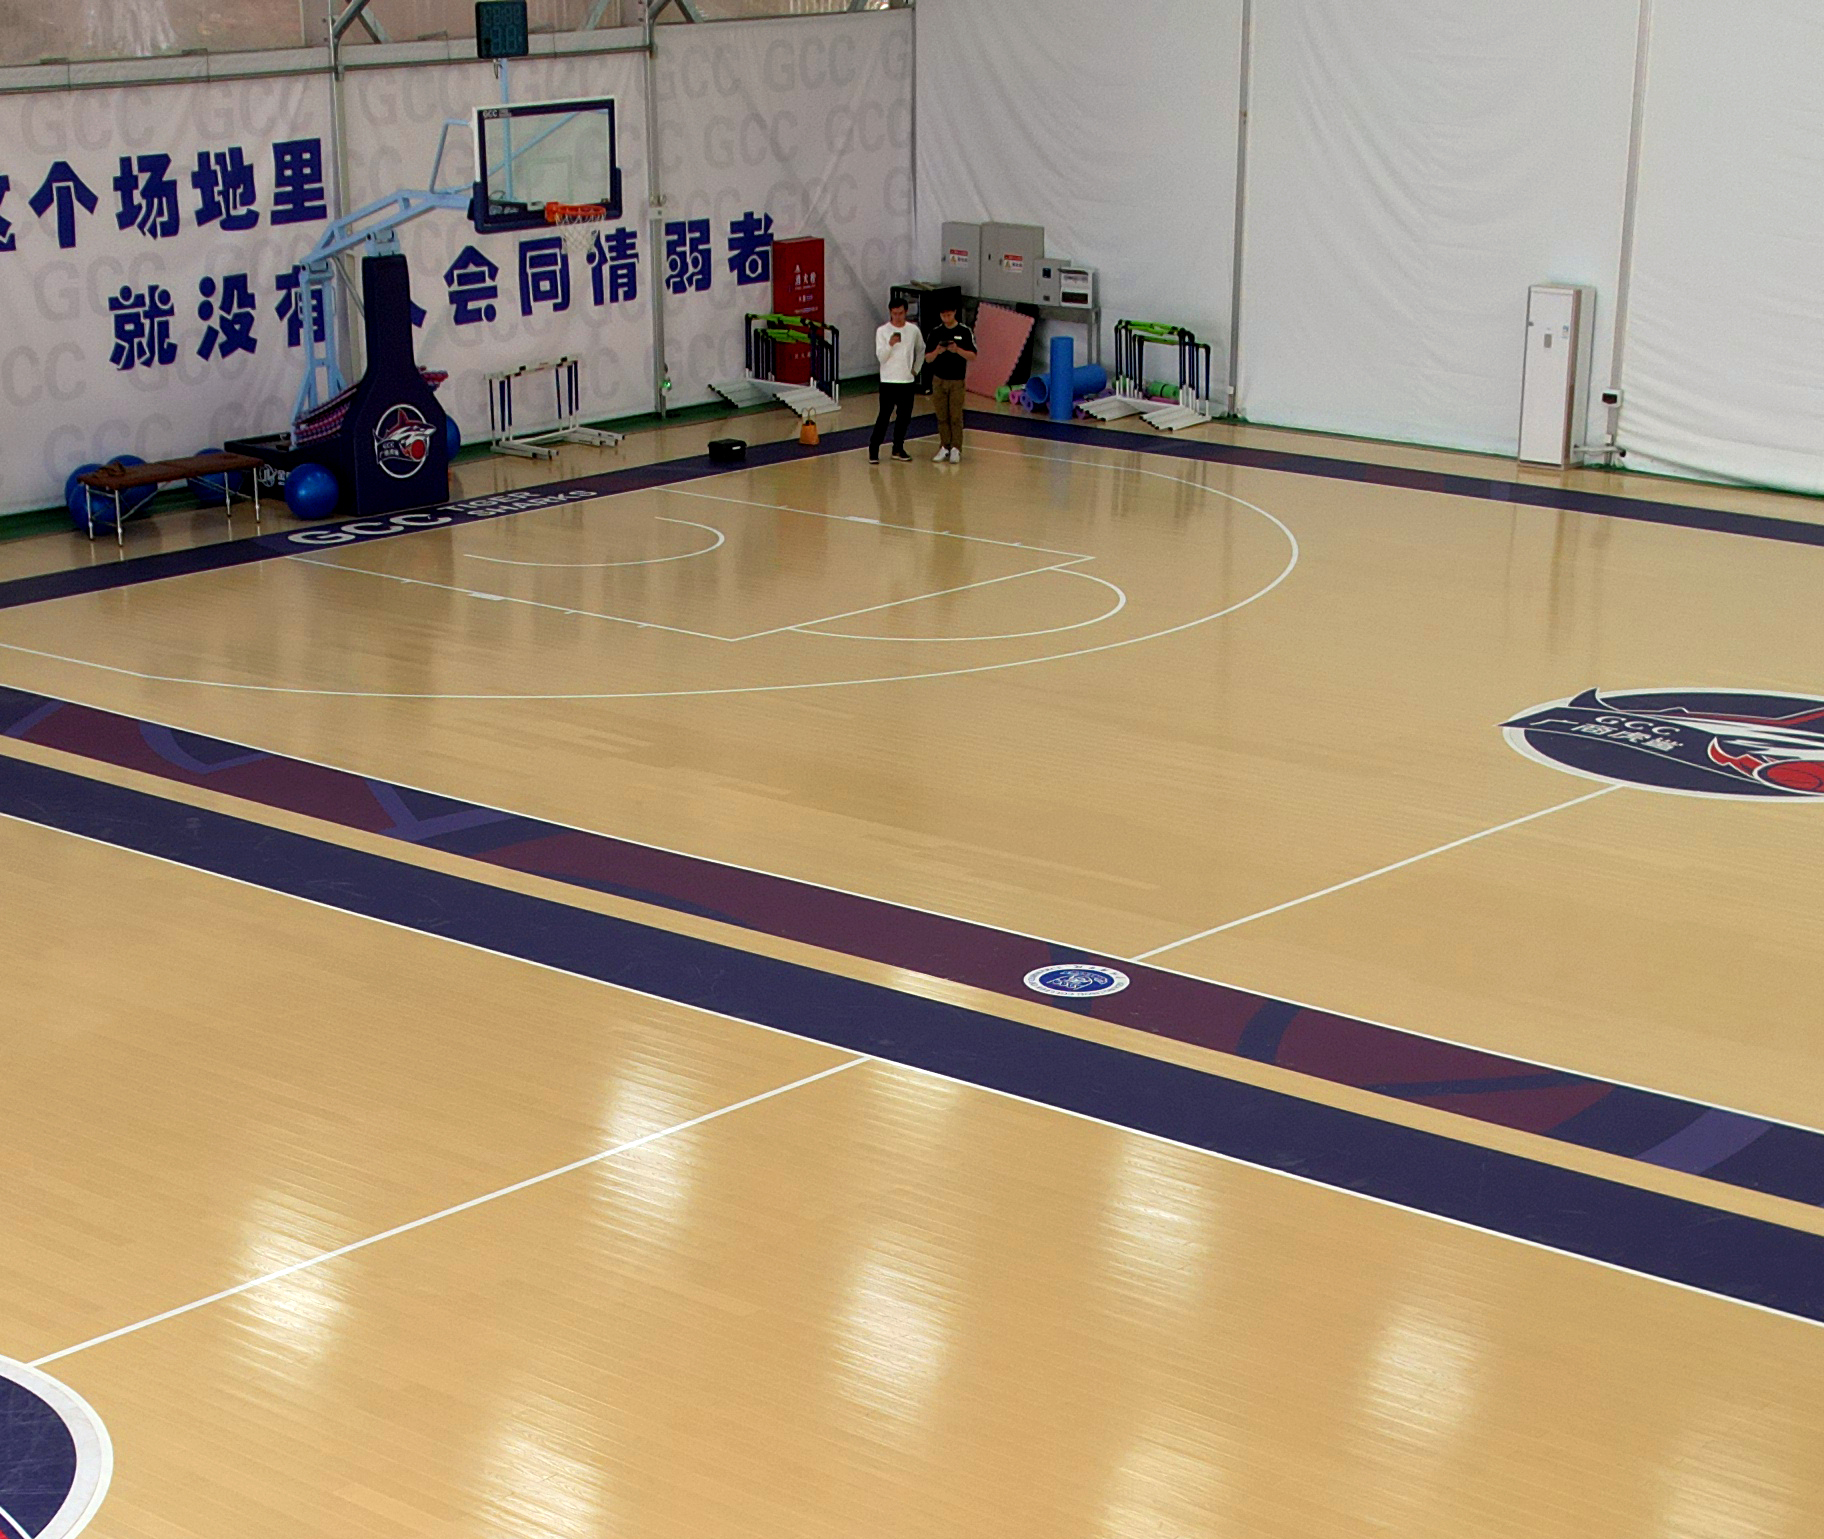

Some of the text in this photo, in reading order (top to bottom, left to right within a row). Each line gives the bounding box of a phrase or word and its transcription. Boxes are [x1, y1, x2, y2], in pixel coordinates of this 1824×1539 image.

[107, 211, 775, 373] 就没有会同情弱者
[287, 491, 540, 545] GCC TIGER
[466, 490, 598, 517] SHARKS
[1594, 715, 1681, 736] GCC
